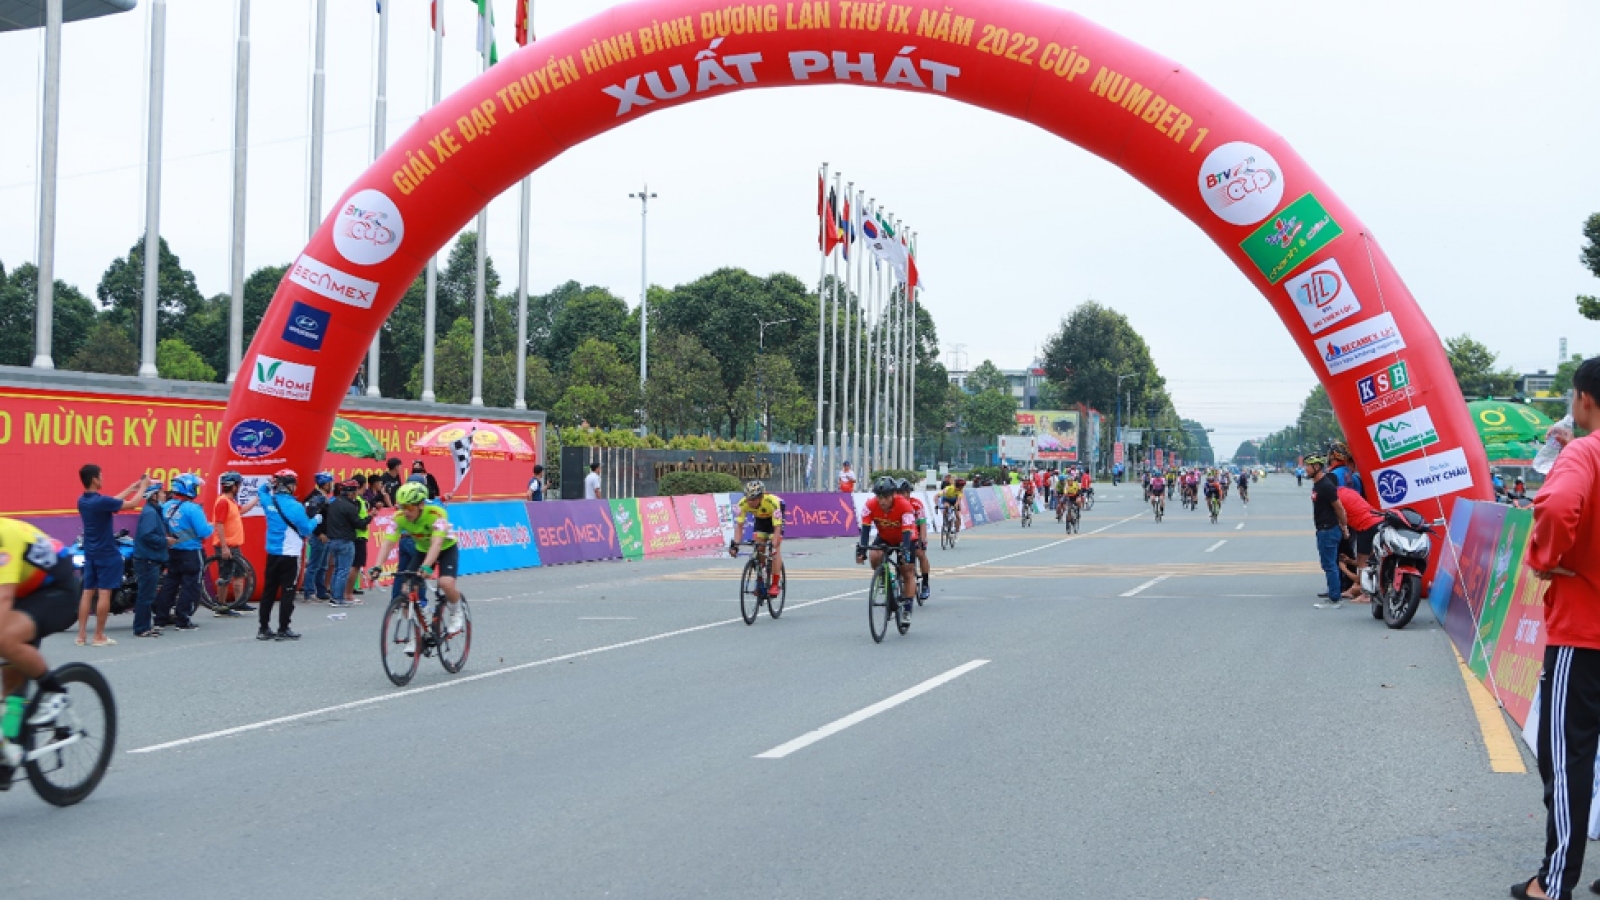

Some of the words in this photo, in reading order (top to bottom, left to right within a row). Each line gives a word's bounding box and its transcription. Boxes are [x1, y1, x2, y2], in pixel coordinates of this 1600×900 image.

[391, 150, 437, 196] GIẢI
[428, 126, 463, 164] XE
[456, 98, 498, 144] ĐẠP
[496, 54, 581, 115] TRUYỀN
[579, 31, 638, 75] HÌNH
[638, 16, 696, 56] BÌNH
[700, 4, 779, 41] DƯƠNG
[886, 4, 913, 35] IX
[916, 5, 977, 47] NĂM
[976, 23, 1040, 66] 2022
[1039, 45, 1091, 83] CÚP
[1089, 65, 1194, 144] NUMBER
[1187, 127, 1210, 153] 1
[602, 36, 764, 118] XUẤT
[788, 45, 961, 93] PHÁT
[275, 376, 312, 393] HOME
[24, 405, 114, 447] MỪNG
[123, 408, 158, 448] KỶ
[165, 413, 223, 455] NIỆM
